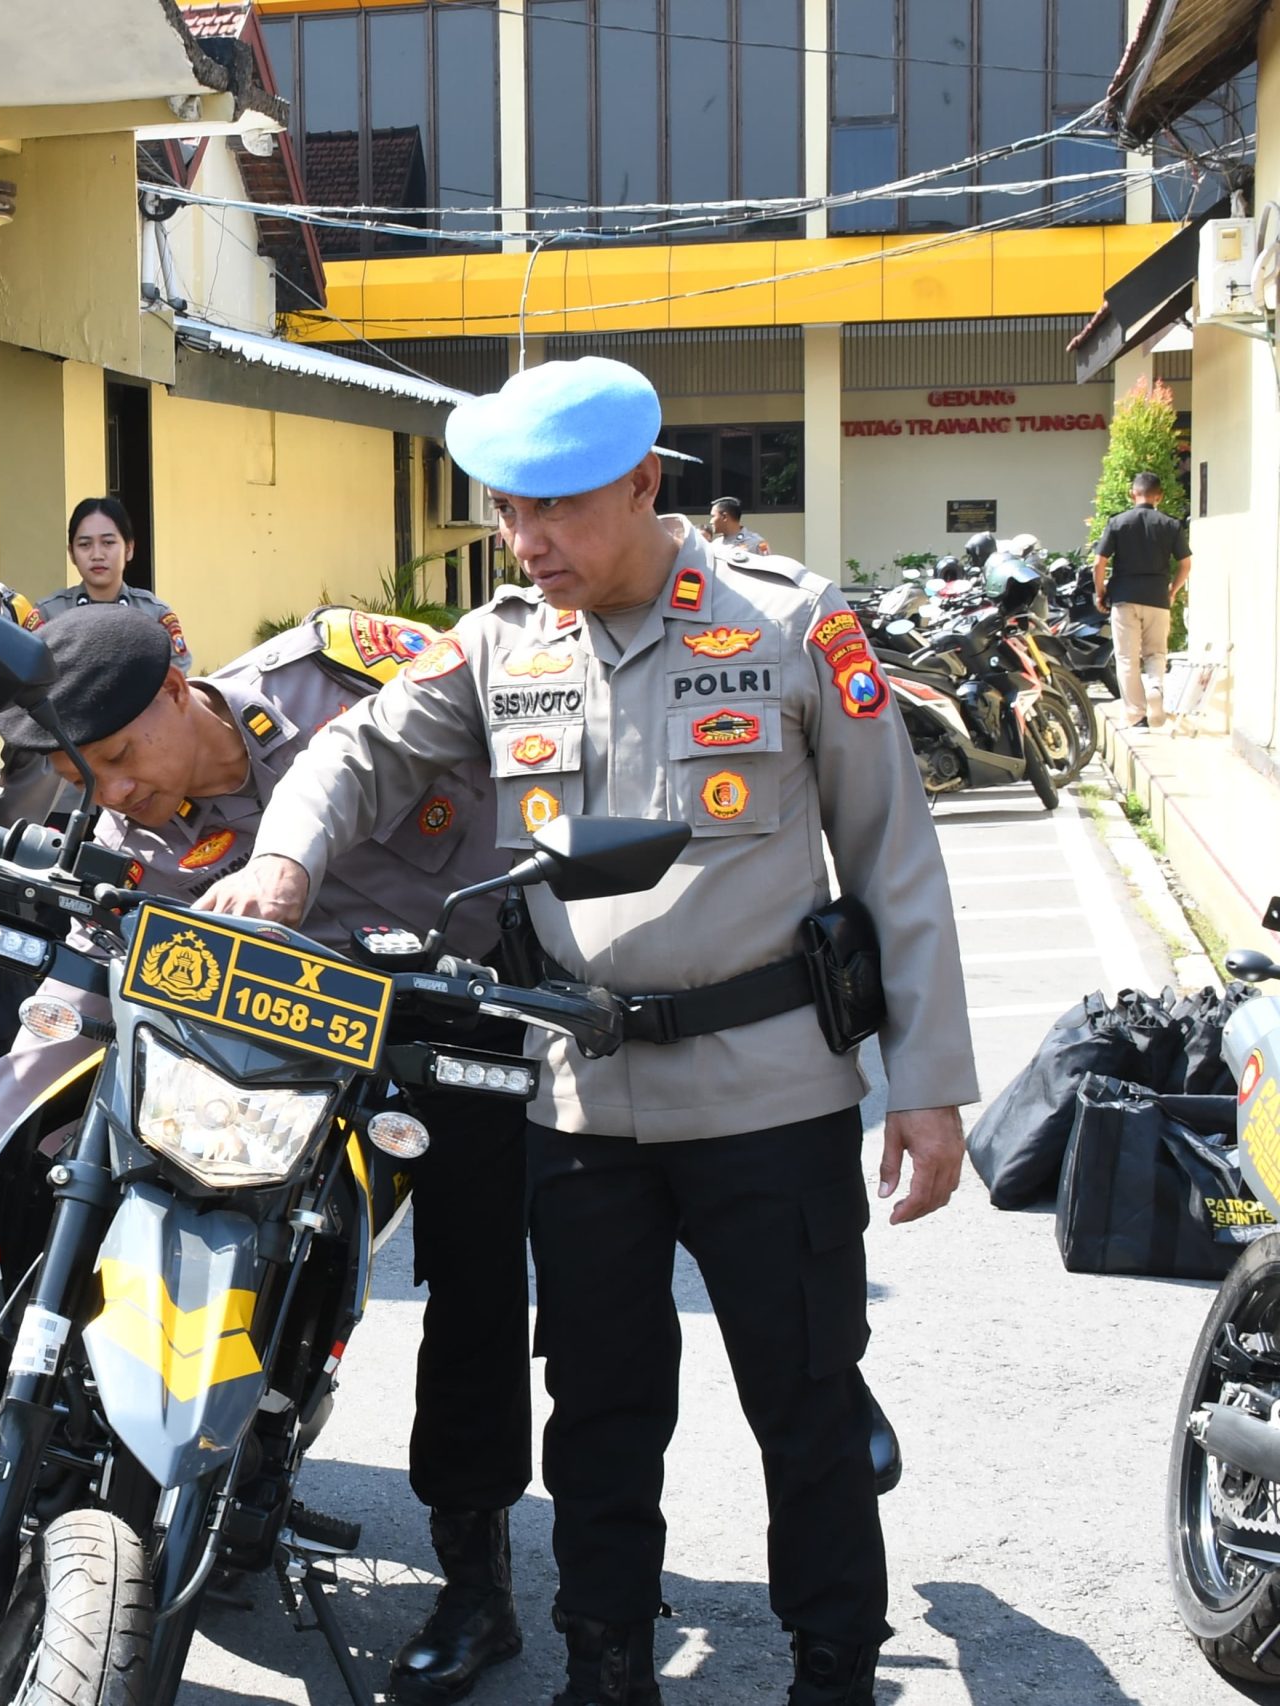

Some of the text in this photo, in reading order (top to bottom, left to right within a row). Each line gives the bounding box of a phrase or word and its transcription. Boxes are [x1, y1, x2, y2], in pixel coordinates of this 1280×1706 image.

[928, 389, 1016, 408] GEDUNG
[841, 419, 902, 437] TATAG
[905, 417, 1012, 436] TRAWANG
[816, 614, 856, 642] POLRES
[674, 669, 771, 700] POLRI
[493, 689, 581, 716] SISWOTO
[294, 960, 326, 992] X
[234, 987, 368, 1050] 1058-52
